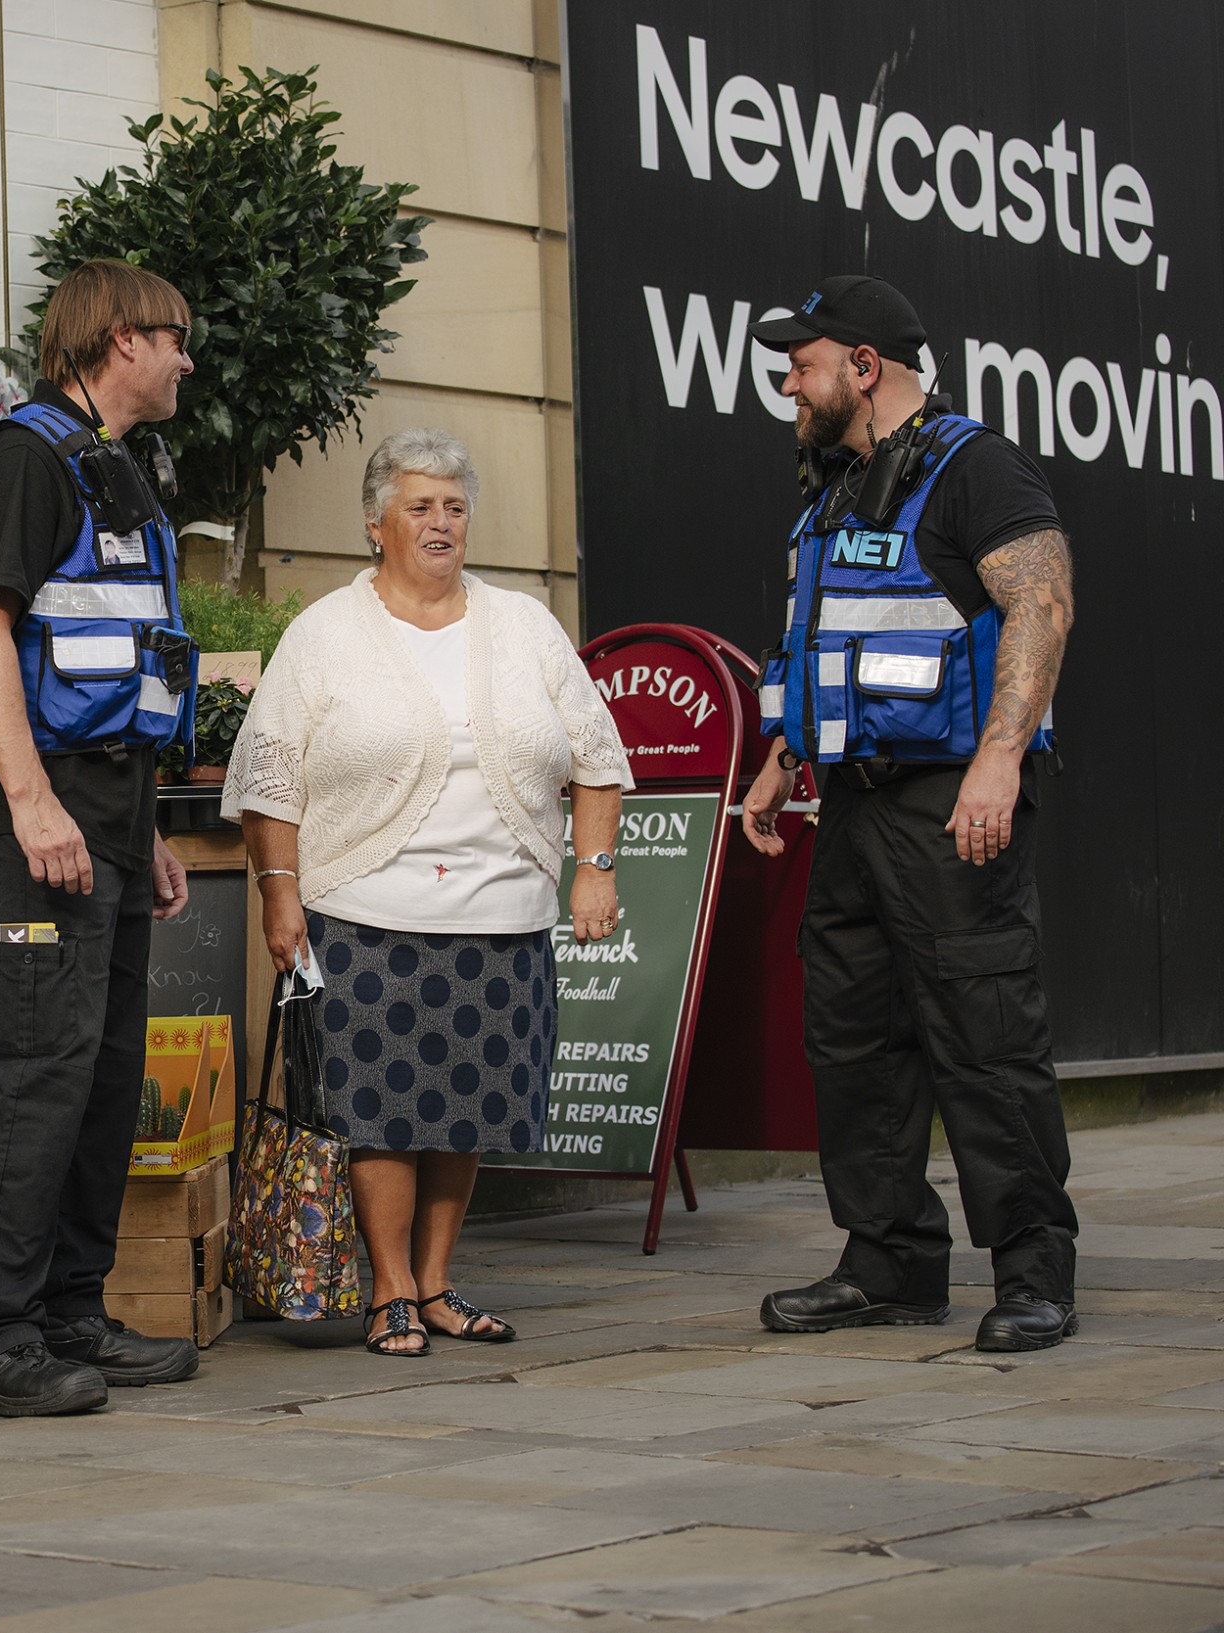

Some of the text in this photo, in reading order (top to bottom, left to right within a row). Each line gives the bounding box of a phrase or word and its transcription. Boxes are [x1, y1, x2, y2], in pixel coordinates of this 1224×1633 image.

[635, 22, 1169, 292] Newcastle,
[831, 528, 905, 568] NE1
[637, 745, 664, 755] Great
[667, 743, 700, 756] People
[620, 845, 649, 857] Great
[651, 845, 688, 858] People
[556, 976, 622, 1001] Foodhall
[556, 1041, 651, 1063] REPAIRS
[549, 1072, 629, 1093] UTTING
[564, 1103, 659, 1125] REPAIRS
